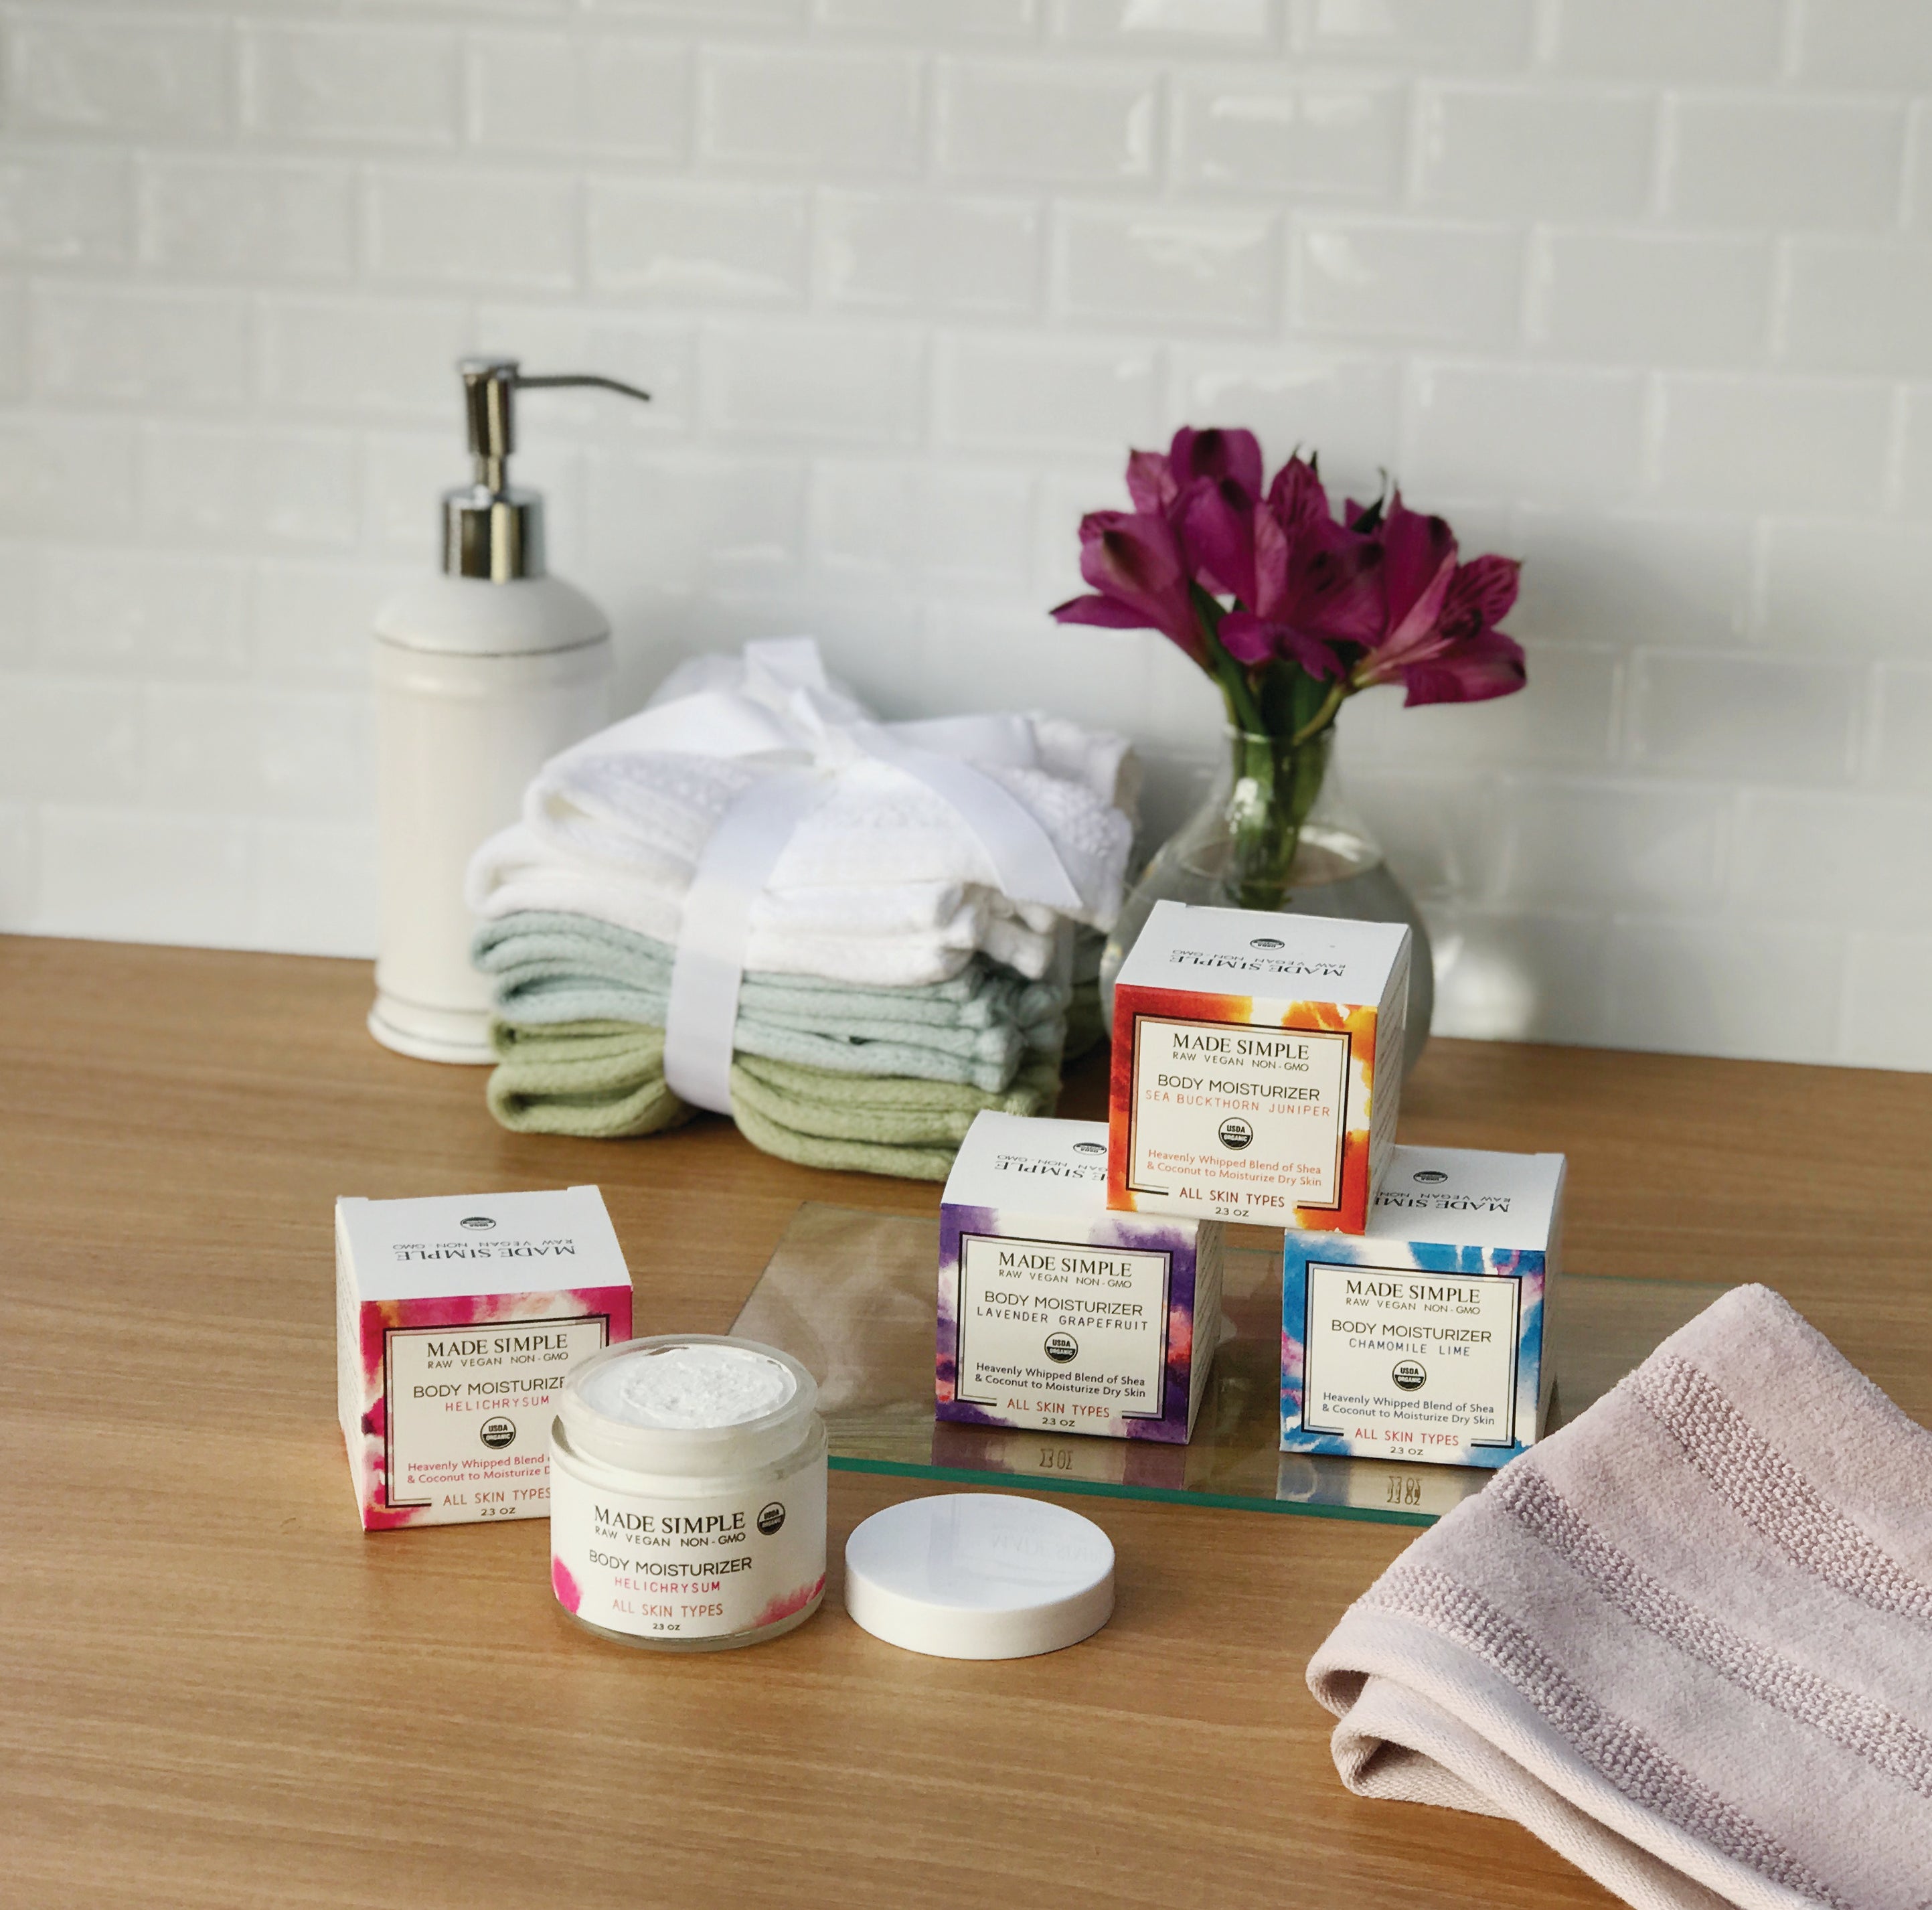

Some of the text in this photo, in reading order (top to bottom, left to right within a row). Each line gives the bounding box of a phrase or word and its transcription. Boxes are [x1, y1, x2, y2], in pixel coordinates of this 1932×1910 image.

[1173, 1033, 1309, 1060] MADE SIMPLE
[1173, 1051, 1196, 1060] RAW
[1204, 1054, 1244, 1066] VEGAN
[1158, 1074, 1319, 1101] BODY MOISTURIZER
[1146, 1090, 1330, 1117] SEA BUCKTHORN JUNIPER
[1226, 1125, 1245, 1133] USDA
[1149, 1149, 1321, 1174] Heavenly Whipped Blend of Shea
[1147, 1162, 1154, 1170] &
[1157, 1163, 1201, 1175] Coconut
[1219, 1170, 1275, 1182] Moisturize
[1278, 1175, 1297, 1186] Dry
[1300, 1176, 1321, 1186] Skin
[1180, 1187, 1285, 1208] ALL SKIN TYPES
[999, 1251, 1132, 1277] MADE SIMPLE
[999, 1269, 1022, 1279] RAW
[1030, 1272, 1068, 1283] VEGAN
[1346, 1280, 1480, 1303] MADE SIMPLE
[985, 1291, 1143, 1316] BODY MOISTURIZER
[1346, 1297, 1369, 1306] RAW
[1377, 1300, 1416, 1310] VEGAN
[977, 1306, 1147, 1331] LAVENDER GRAPEFRUIT
[1332, 1320, 1492, 1343] BODY MOISTURIZER
[427, 1334, 568, 1357] MADE SIMPLE
[1052, 1339, 1070, 1347] USDA
[1350, 1338, 1470, 1356] CHAMOMILE LIME
[428, 1360, 453, 1369] RAW
[461, 1357, 502, 1367] VEGAN
[1400, 1367, 1419, 1375] USDA
[977, 1362, 1145, 1386] Heavenly Whipped Blend of Shea
[414, 1384, 462, 1398] BODY
[975, 1374, 1145, 1398] & Coconut to Moisturize Dry Skin
[446, 1395, 549, 1412] HELICHRYSUM
[1007, 1398, 1109, 1418] ALL SKIN TYPES
[1323, 1392, 1494, 1413] Heavenly Whipped Blend of Shea
[1322, 1403, 1494, 1425] & Coconut to Moisturize Dry Skin
[488, 1424, 507, 1432] USDA
[1355, 1428, 1459, 1446] ALL SKIN TYPES
[408, 1461, 458, 1471] Heavenly
[462, 1457, 511, 1469] Whipped
[514, 1453, 544, 1465] Blend
[408, 1475, 415, 1484] &
[418, 1474, 465, 1483] Coconut
[484, 1468, 541, 1479] Moisturize
[443, 1487, 550, 1506] ALL SKIN TYPES
[594, 1505, 656, 1532] MADE
[661, 1512, 746, 1533] SIMPLE
[594, 1525, 617, 1539] RAW
[625, 1534, 670, 1546] VEGAN
[589, 1549, 752, 1576] BODY MOISTURIZER
[615, 1577, 720, 1593] HELICHRYSUM
[612, 1599, 723, 1617] ALL SKIN TYPES
